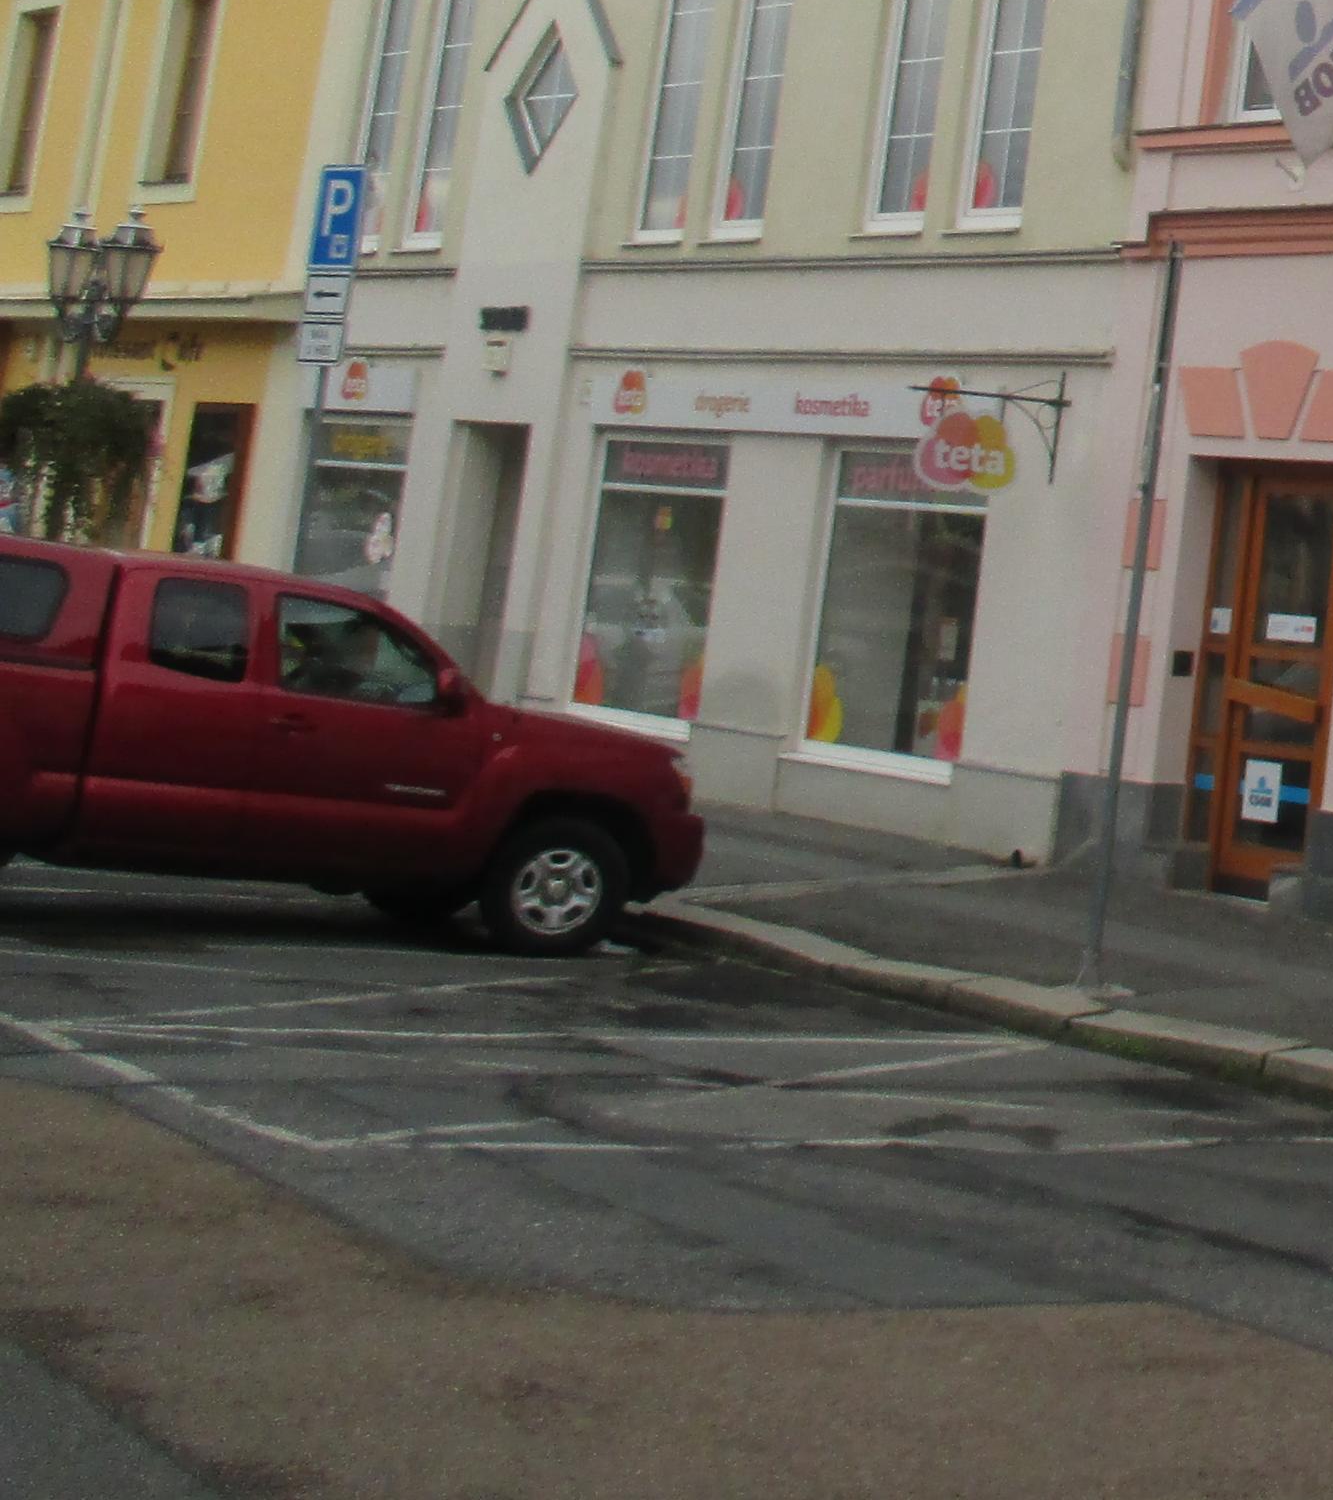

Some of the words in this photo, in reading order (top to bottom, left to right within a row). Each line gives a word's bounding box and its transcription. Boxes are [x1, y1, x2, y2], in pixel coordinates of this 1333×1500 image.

[321, 179, 355, 237] P
[794, 392, 869, 418] kosmetika
[934, 438, 1005, 476] teta
